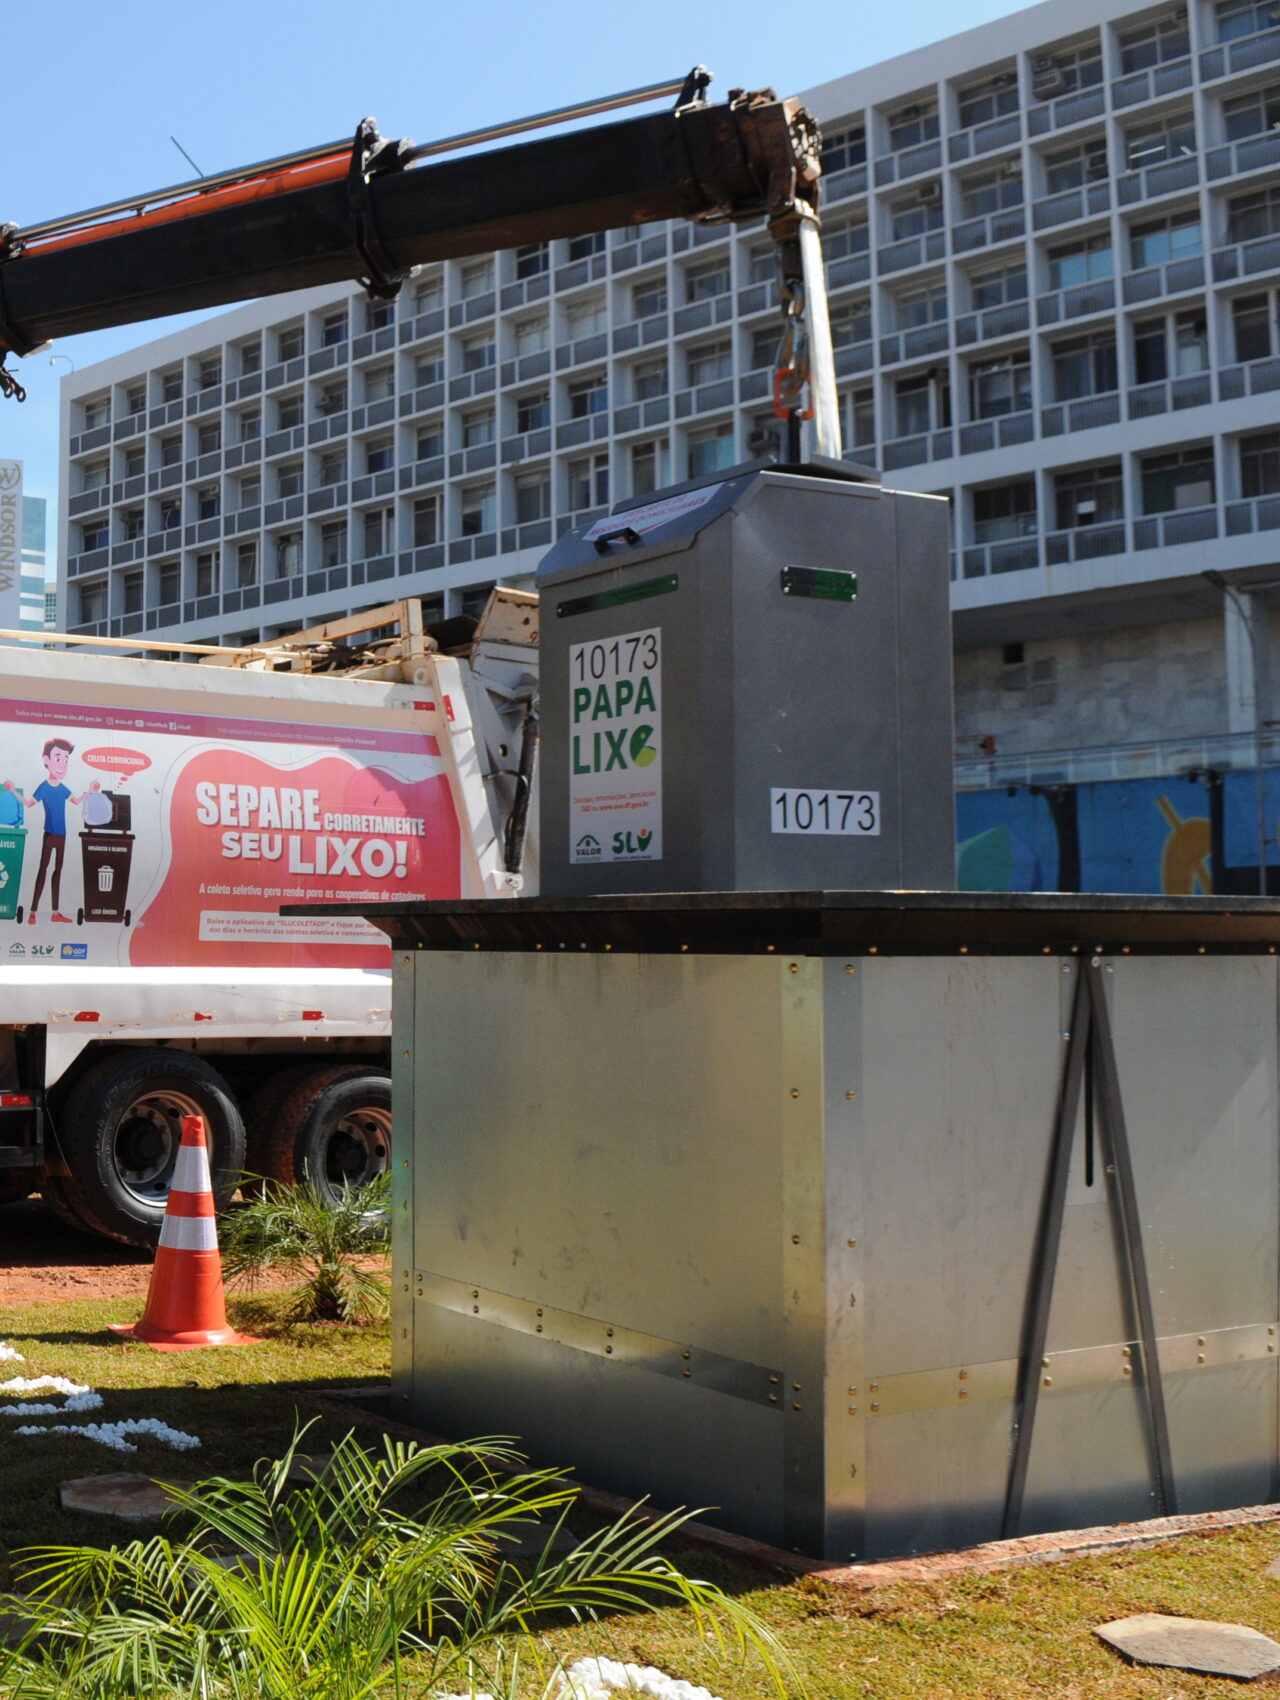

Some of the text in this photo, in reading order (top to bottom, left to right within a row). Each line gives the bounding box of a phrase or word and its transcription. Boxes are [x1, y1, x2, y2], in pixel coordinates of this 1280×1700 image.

[0, 493, 17, 592] WINDSOR
[575, 634, 658, 681] 10173
[574, 675, 656, 724] PAPA
[195, 781, 426, 837] SEPARE CORRETAMENTE
[776, 792, 875, 831] 10173
[221, 831, 408, 878] SEU LIXO!
[576, 848, 602, 856] VALOR
[199, 883, 205, 894] A
[207, 884, 230, 895] coleta
[232, 885, 262, 896] seletiva
[264, 888, 281, 898] gera
[283, 887, 304, 897] renda
[306, 889, 323, 900] para
[335, 889, 379, 901] cooperativas
[381, 890, 390, 900] de
[31, 945, 55, 955] SLU
